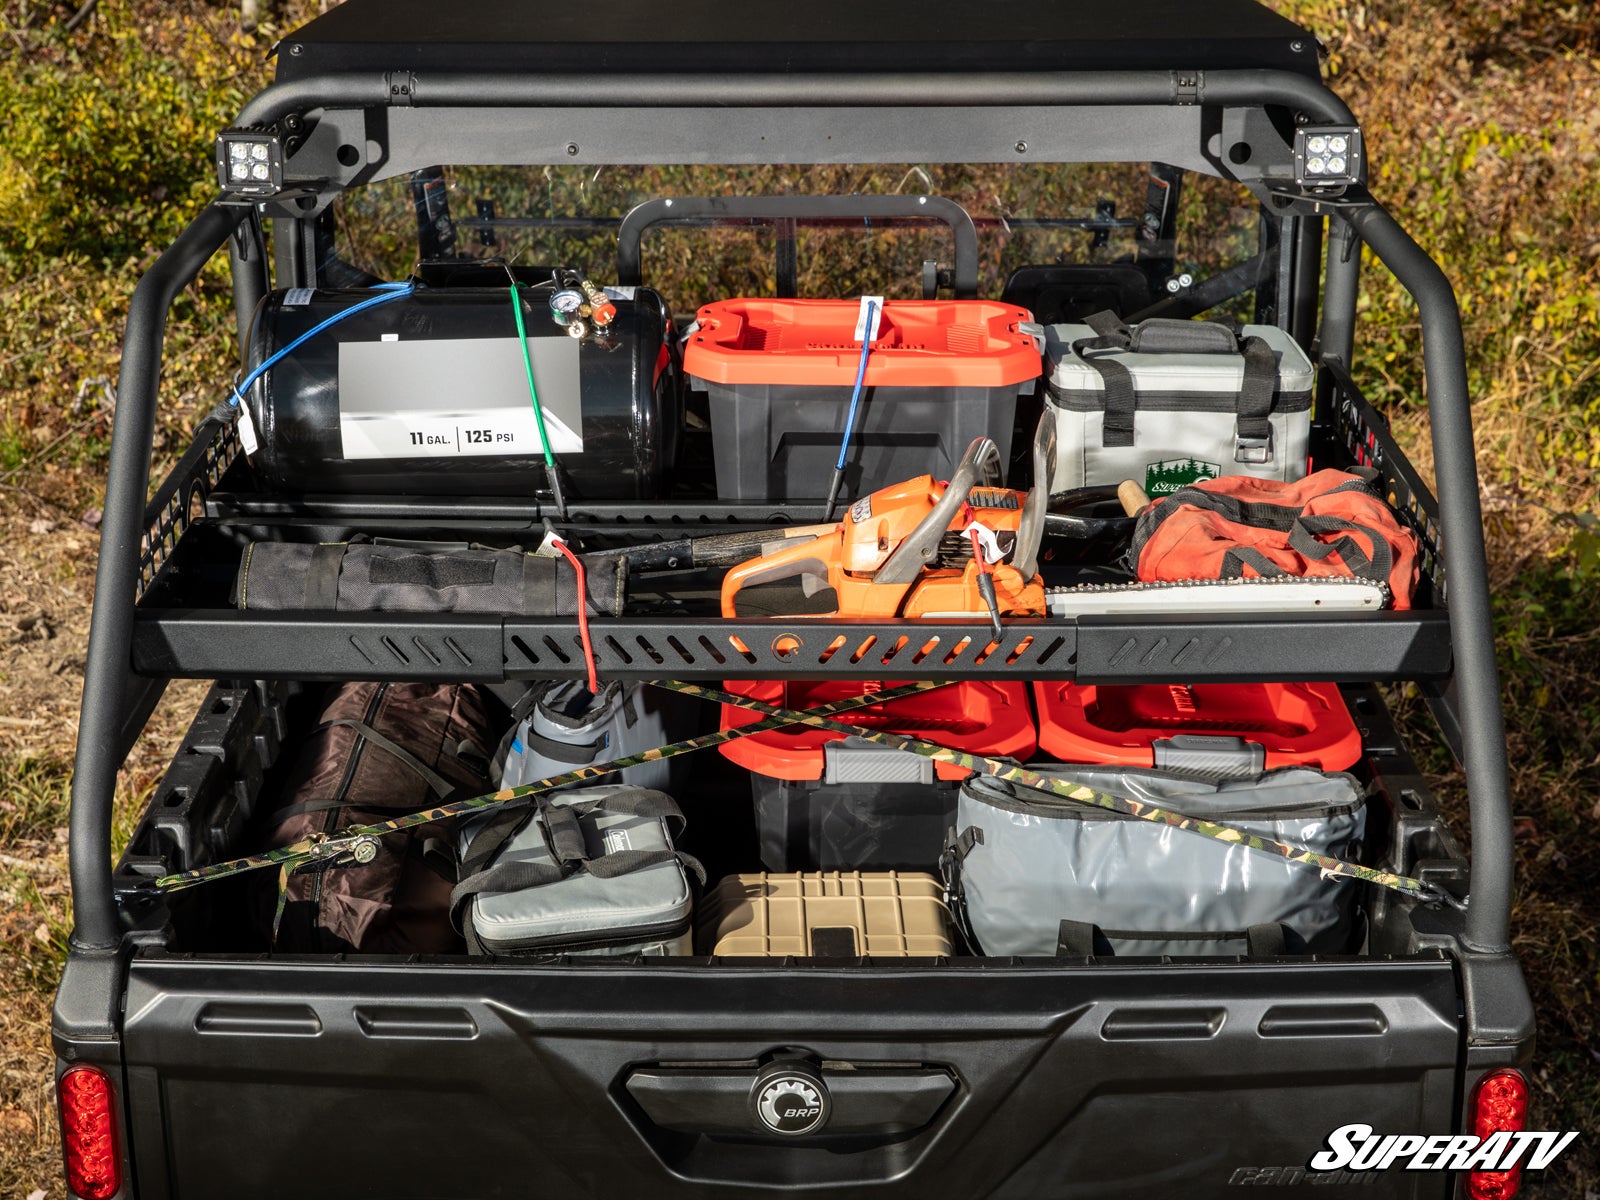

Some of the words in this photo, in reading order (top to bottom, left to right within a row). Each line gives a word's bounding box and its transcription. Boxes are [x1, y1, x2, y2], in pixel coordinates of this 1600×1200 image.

[410, 432, 424, 445] 11
[426, 435, 451, 445] GAL.
[465, 429, 493, 443] 125
[496, 433, 514, 442] PSI
[784, 1108, 819, 1118] BRP
